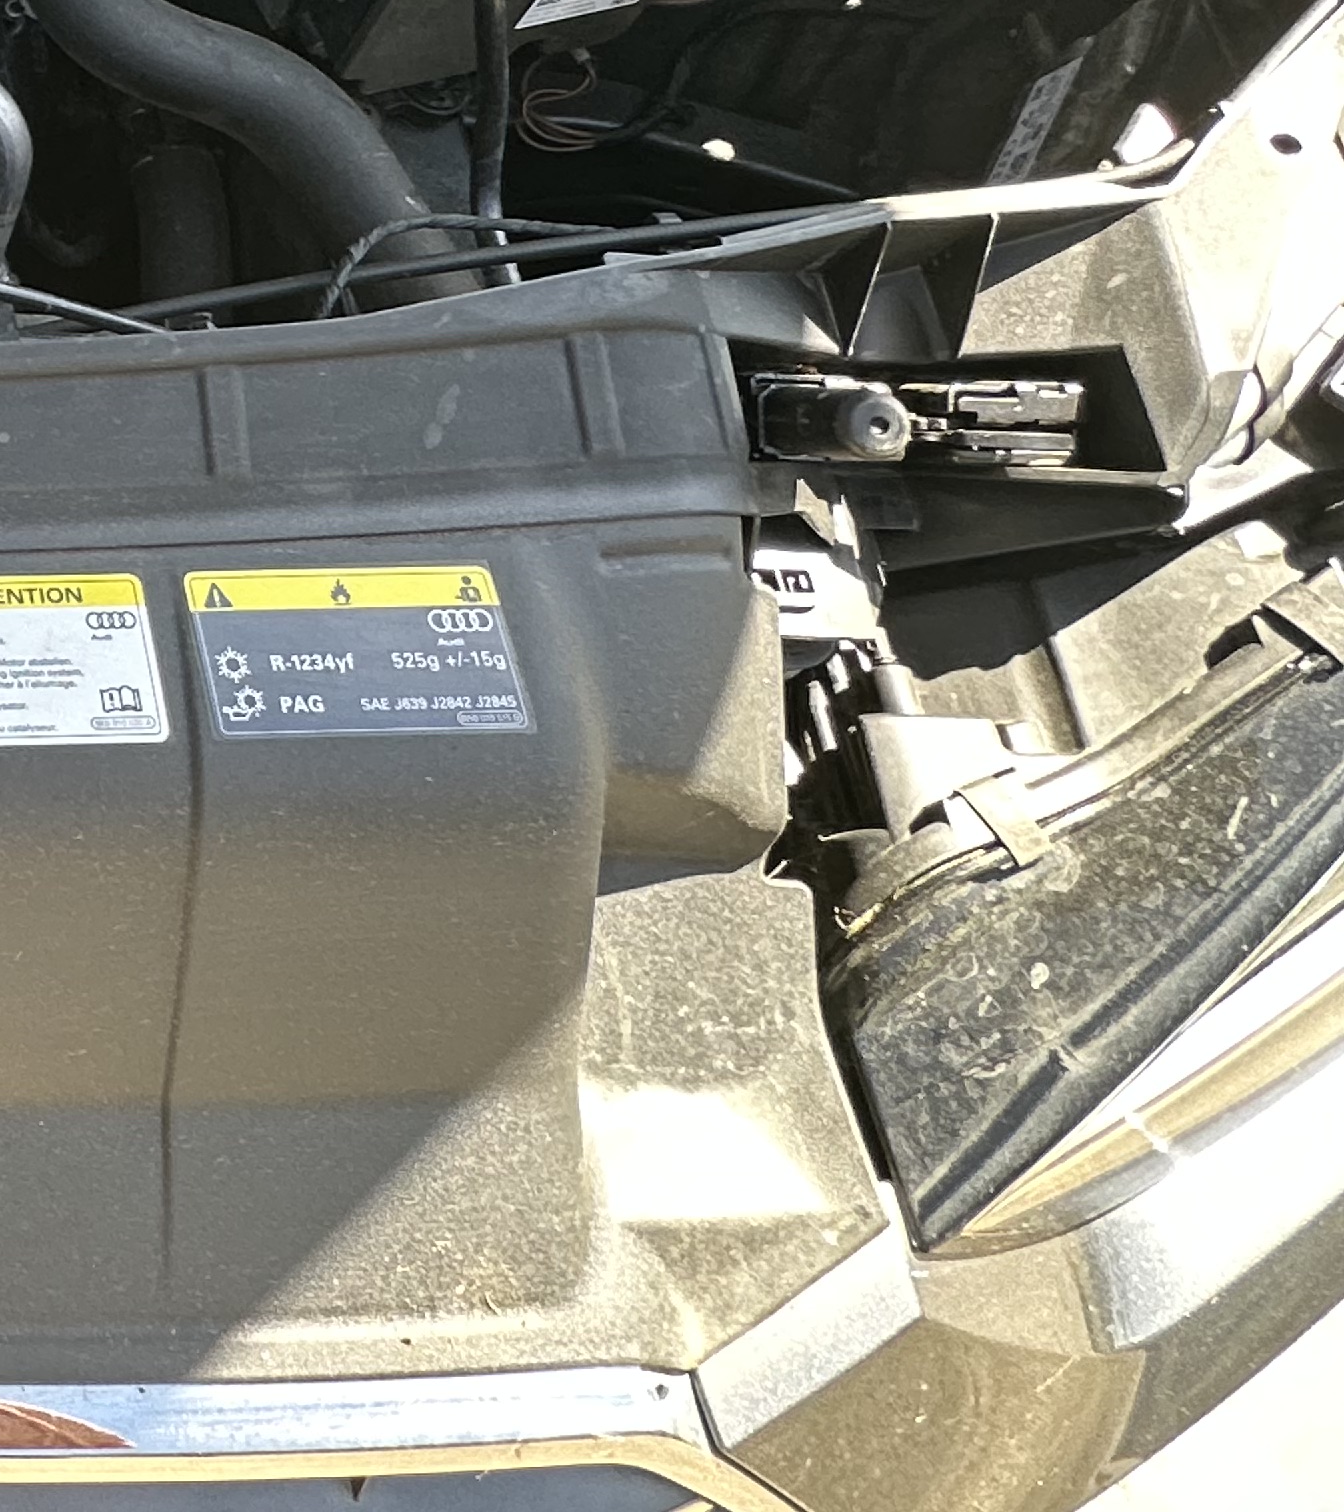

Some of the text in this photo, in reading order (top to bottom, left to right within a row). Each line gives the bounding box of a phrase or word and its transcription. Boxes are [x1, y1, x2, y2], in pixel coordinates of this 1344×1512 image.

[437, 638, 465, 646] Audi
[269, 650, 507, 674] R-1234yf 525g +/-15g
[279, 695, 518, 714] PAG SAE J639 J2842 J2845
